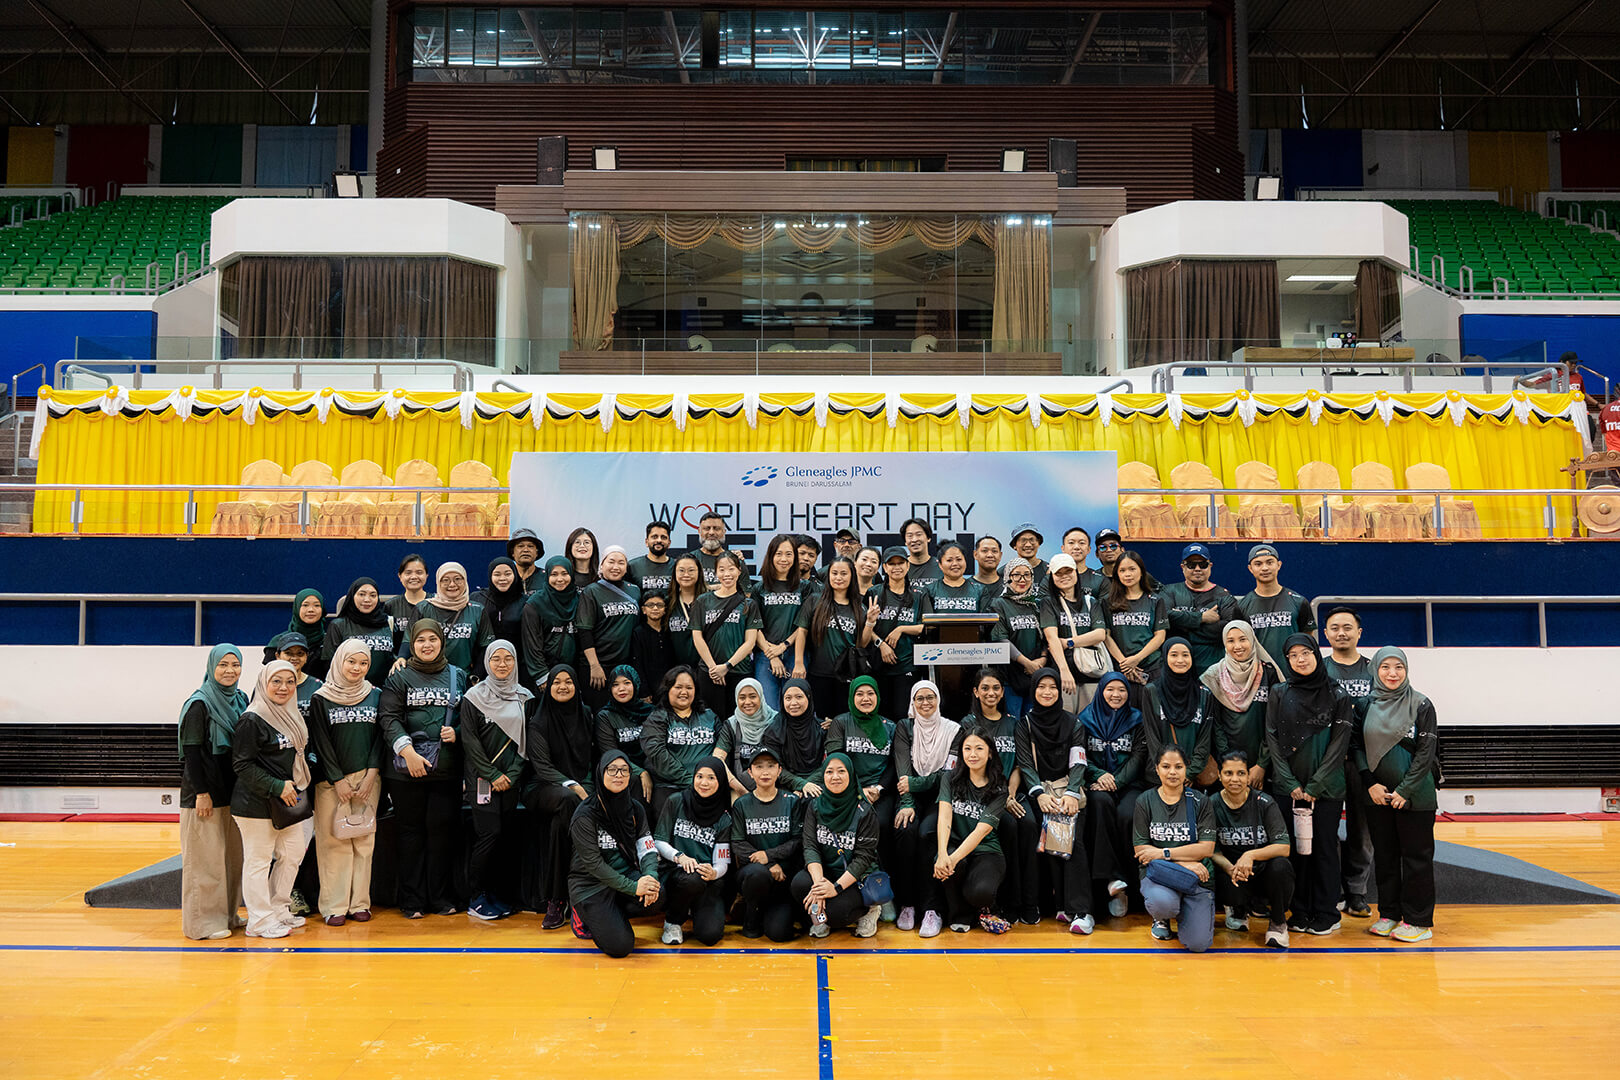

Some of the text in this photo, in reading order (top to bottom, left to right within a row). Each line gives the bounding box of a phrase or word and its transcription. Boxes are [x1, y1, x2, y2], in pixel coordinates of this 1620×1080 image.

[785, 466, 882, 480] Gleneagles JPMC
[790, 503, 898, 531] HEART
[911, 502, 976, 531] DAY
[1112, 615, 1150, 623] HEALTH
[1250, 615, 1292, 625] HEALTH
[946, 647, 1002, 656] Gleneagles JPMC
[329, 710, 377, 721] HEALTH
[668, 730, 714, 739] HEALTH
[667, 738, 691, 746] FEST
[746, 820, 790, 830] HEALTH
[747, 827, 767, 835] FEST
